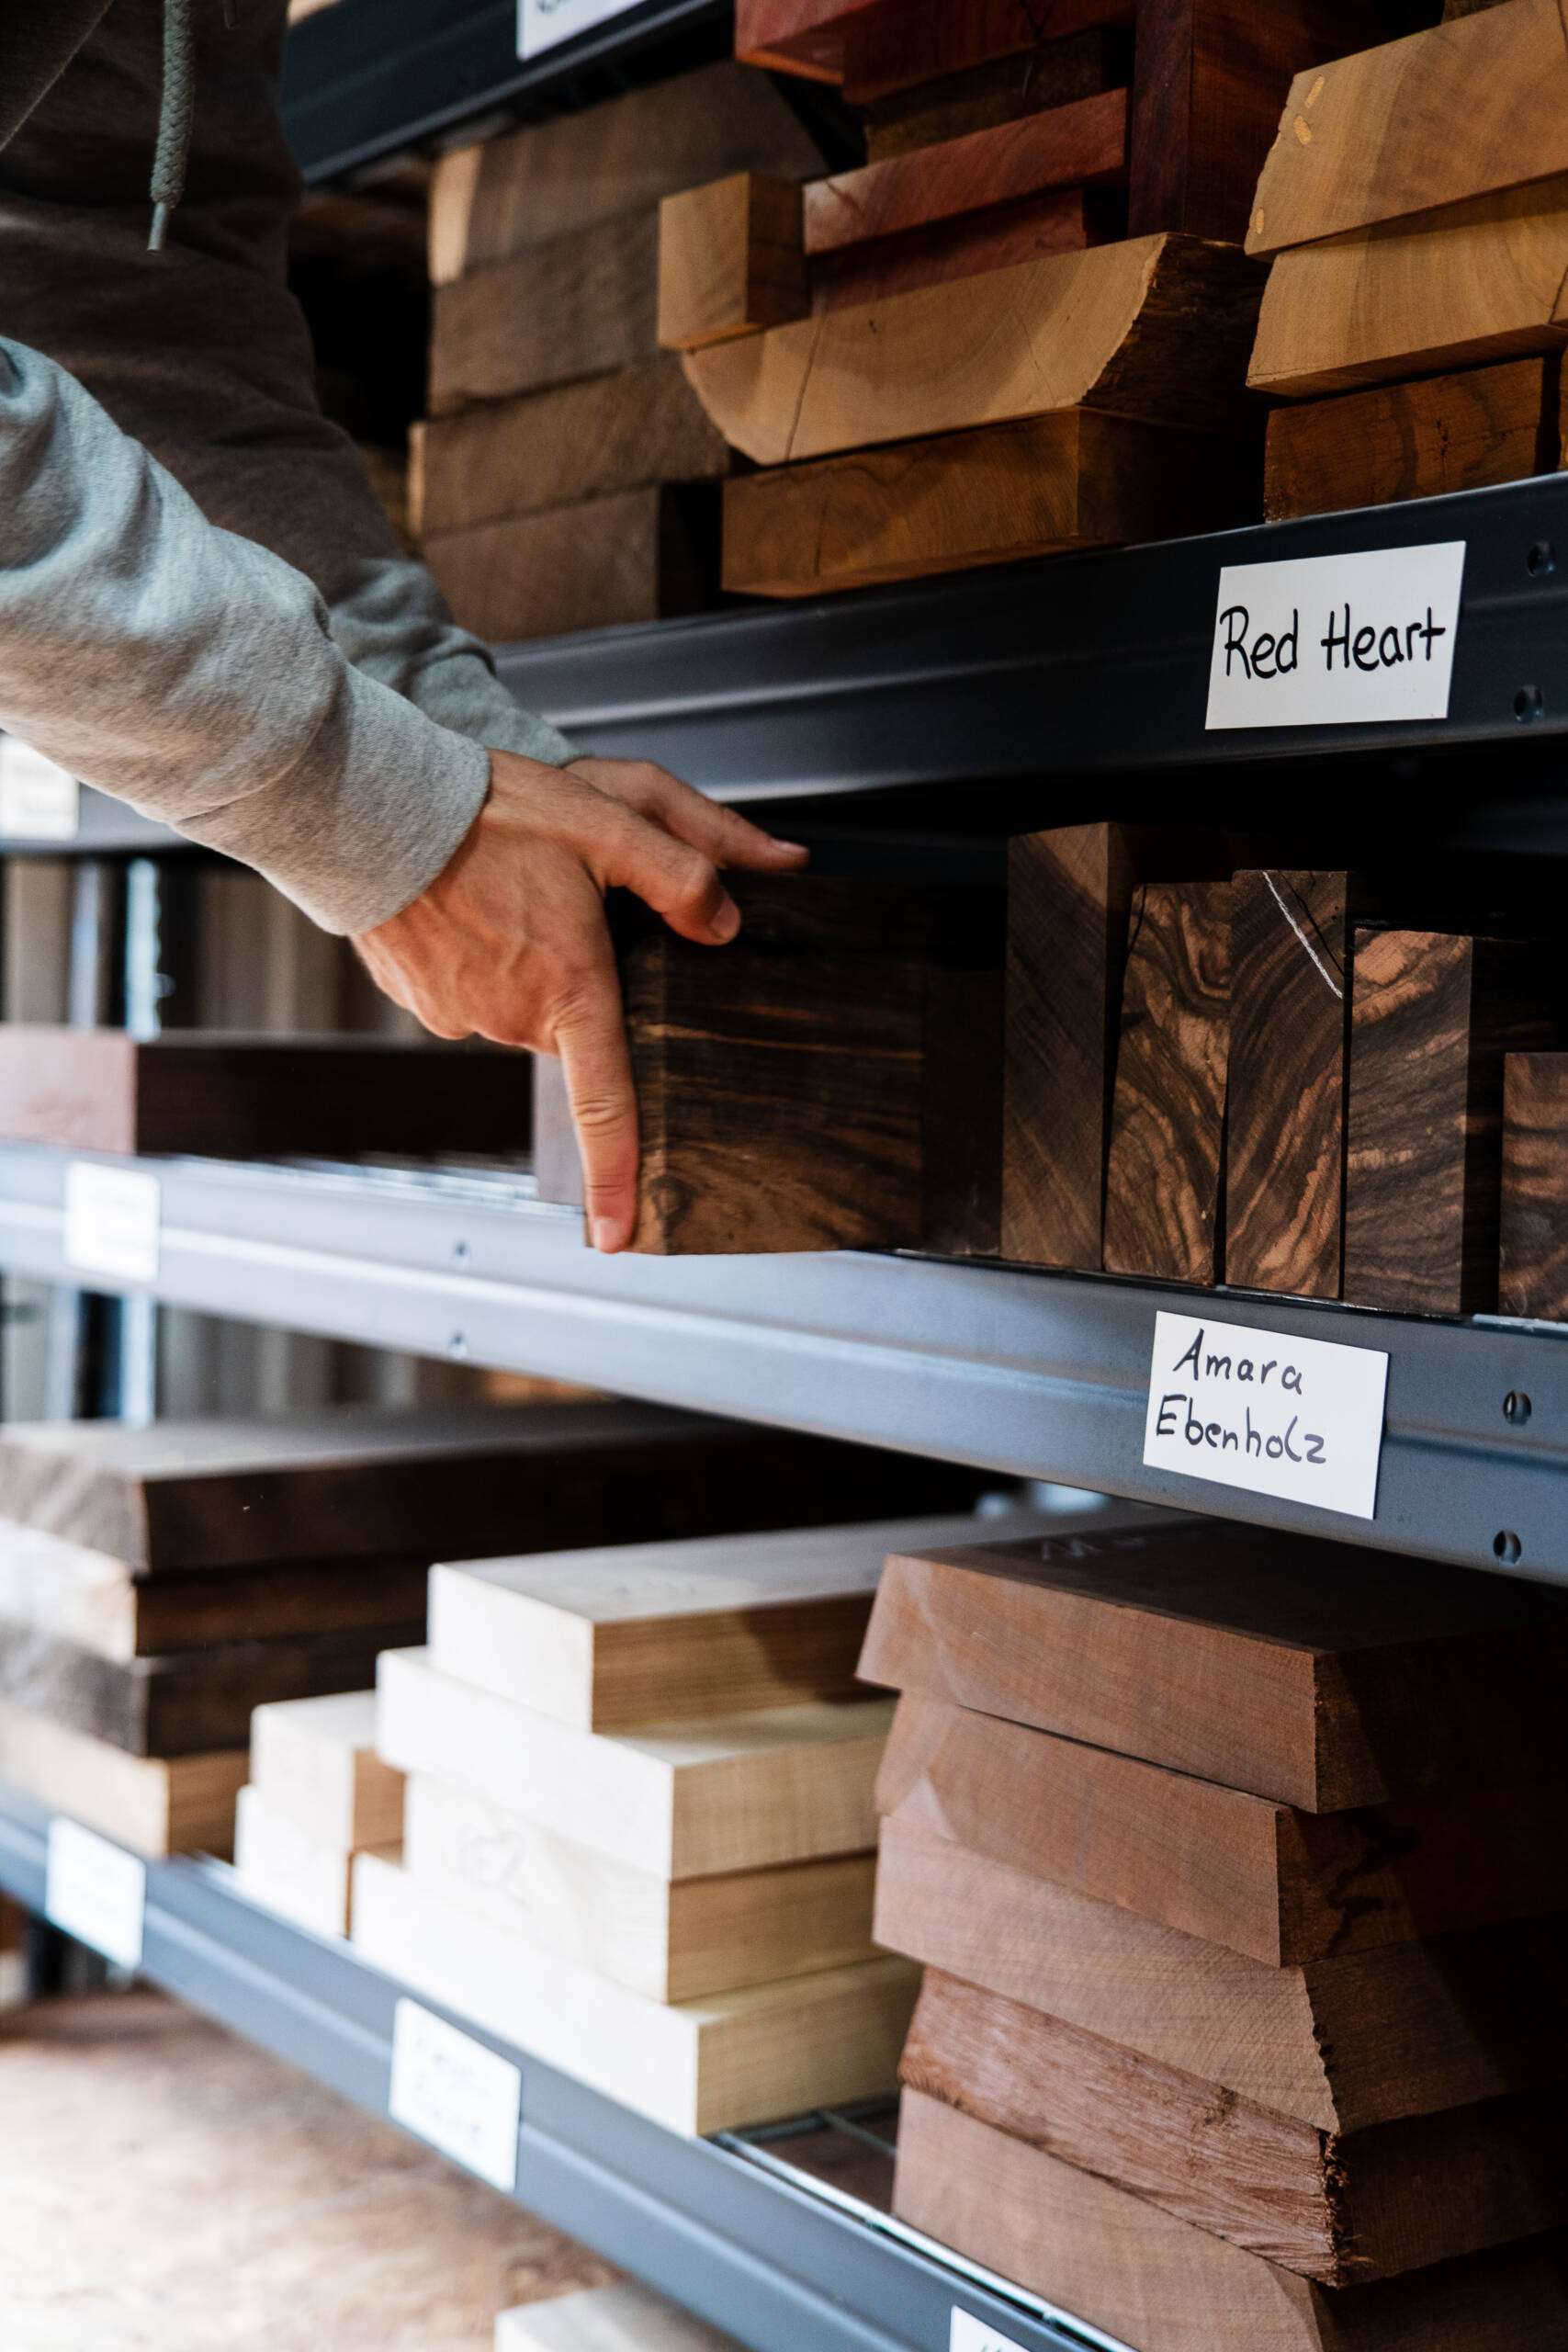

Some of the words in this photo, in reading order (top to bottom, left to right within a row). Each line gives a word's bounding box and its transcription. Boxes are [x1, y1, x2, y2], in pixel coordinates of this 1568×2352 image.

[1219, 605, 1299, 680] Red
[1320, 602, 1447, 672] Heart
[1172, 1328, 1303, 1395] Amara
[1156, 1394, 1327, 1464] Ebenholz
